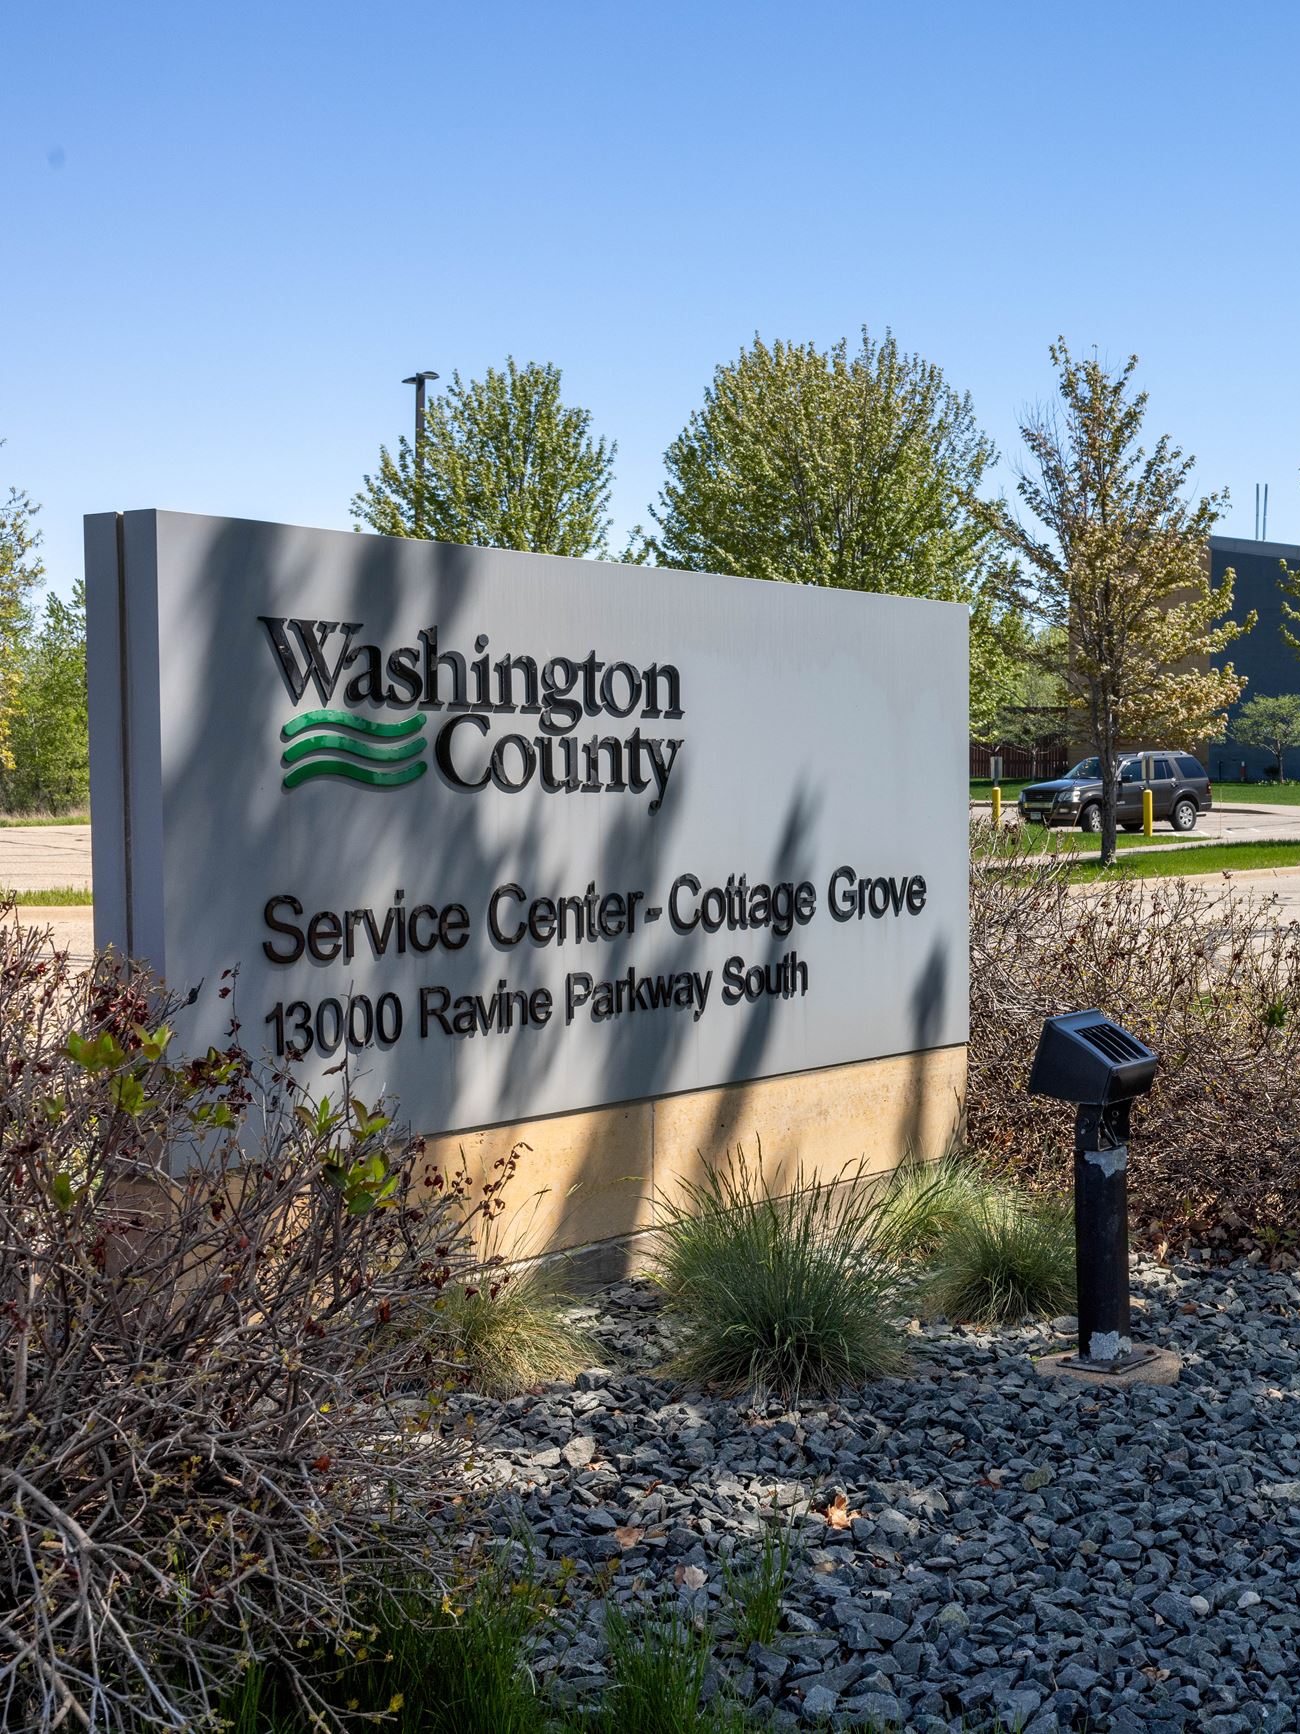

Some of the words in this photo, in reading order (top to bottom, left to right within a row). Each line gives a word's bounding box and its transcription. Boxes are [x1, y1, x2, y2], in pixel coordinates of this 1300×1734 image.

[257, 615, 682, 731] Washington
[434, 713, 685, 811] County
[263, 889, 471, 964] Service
[829, 865, 927, 920] Grove
[264, 991, 403, 1057] 13000
[418, 978, 553, 1039] Ravine
[565, 968, 714, 1020] Parkway
[722, 951, 810, 1002] South
